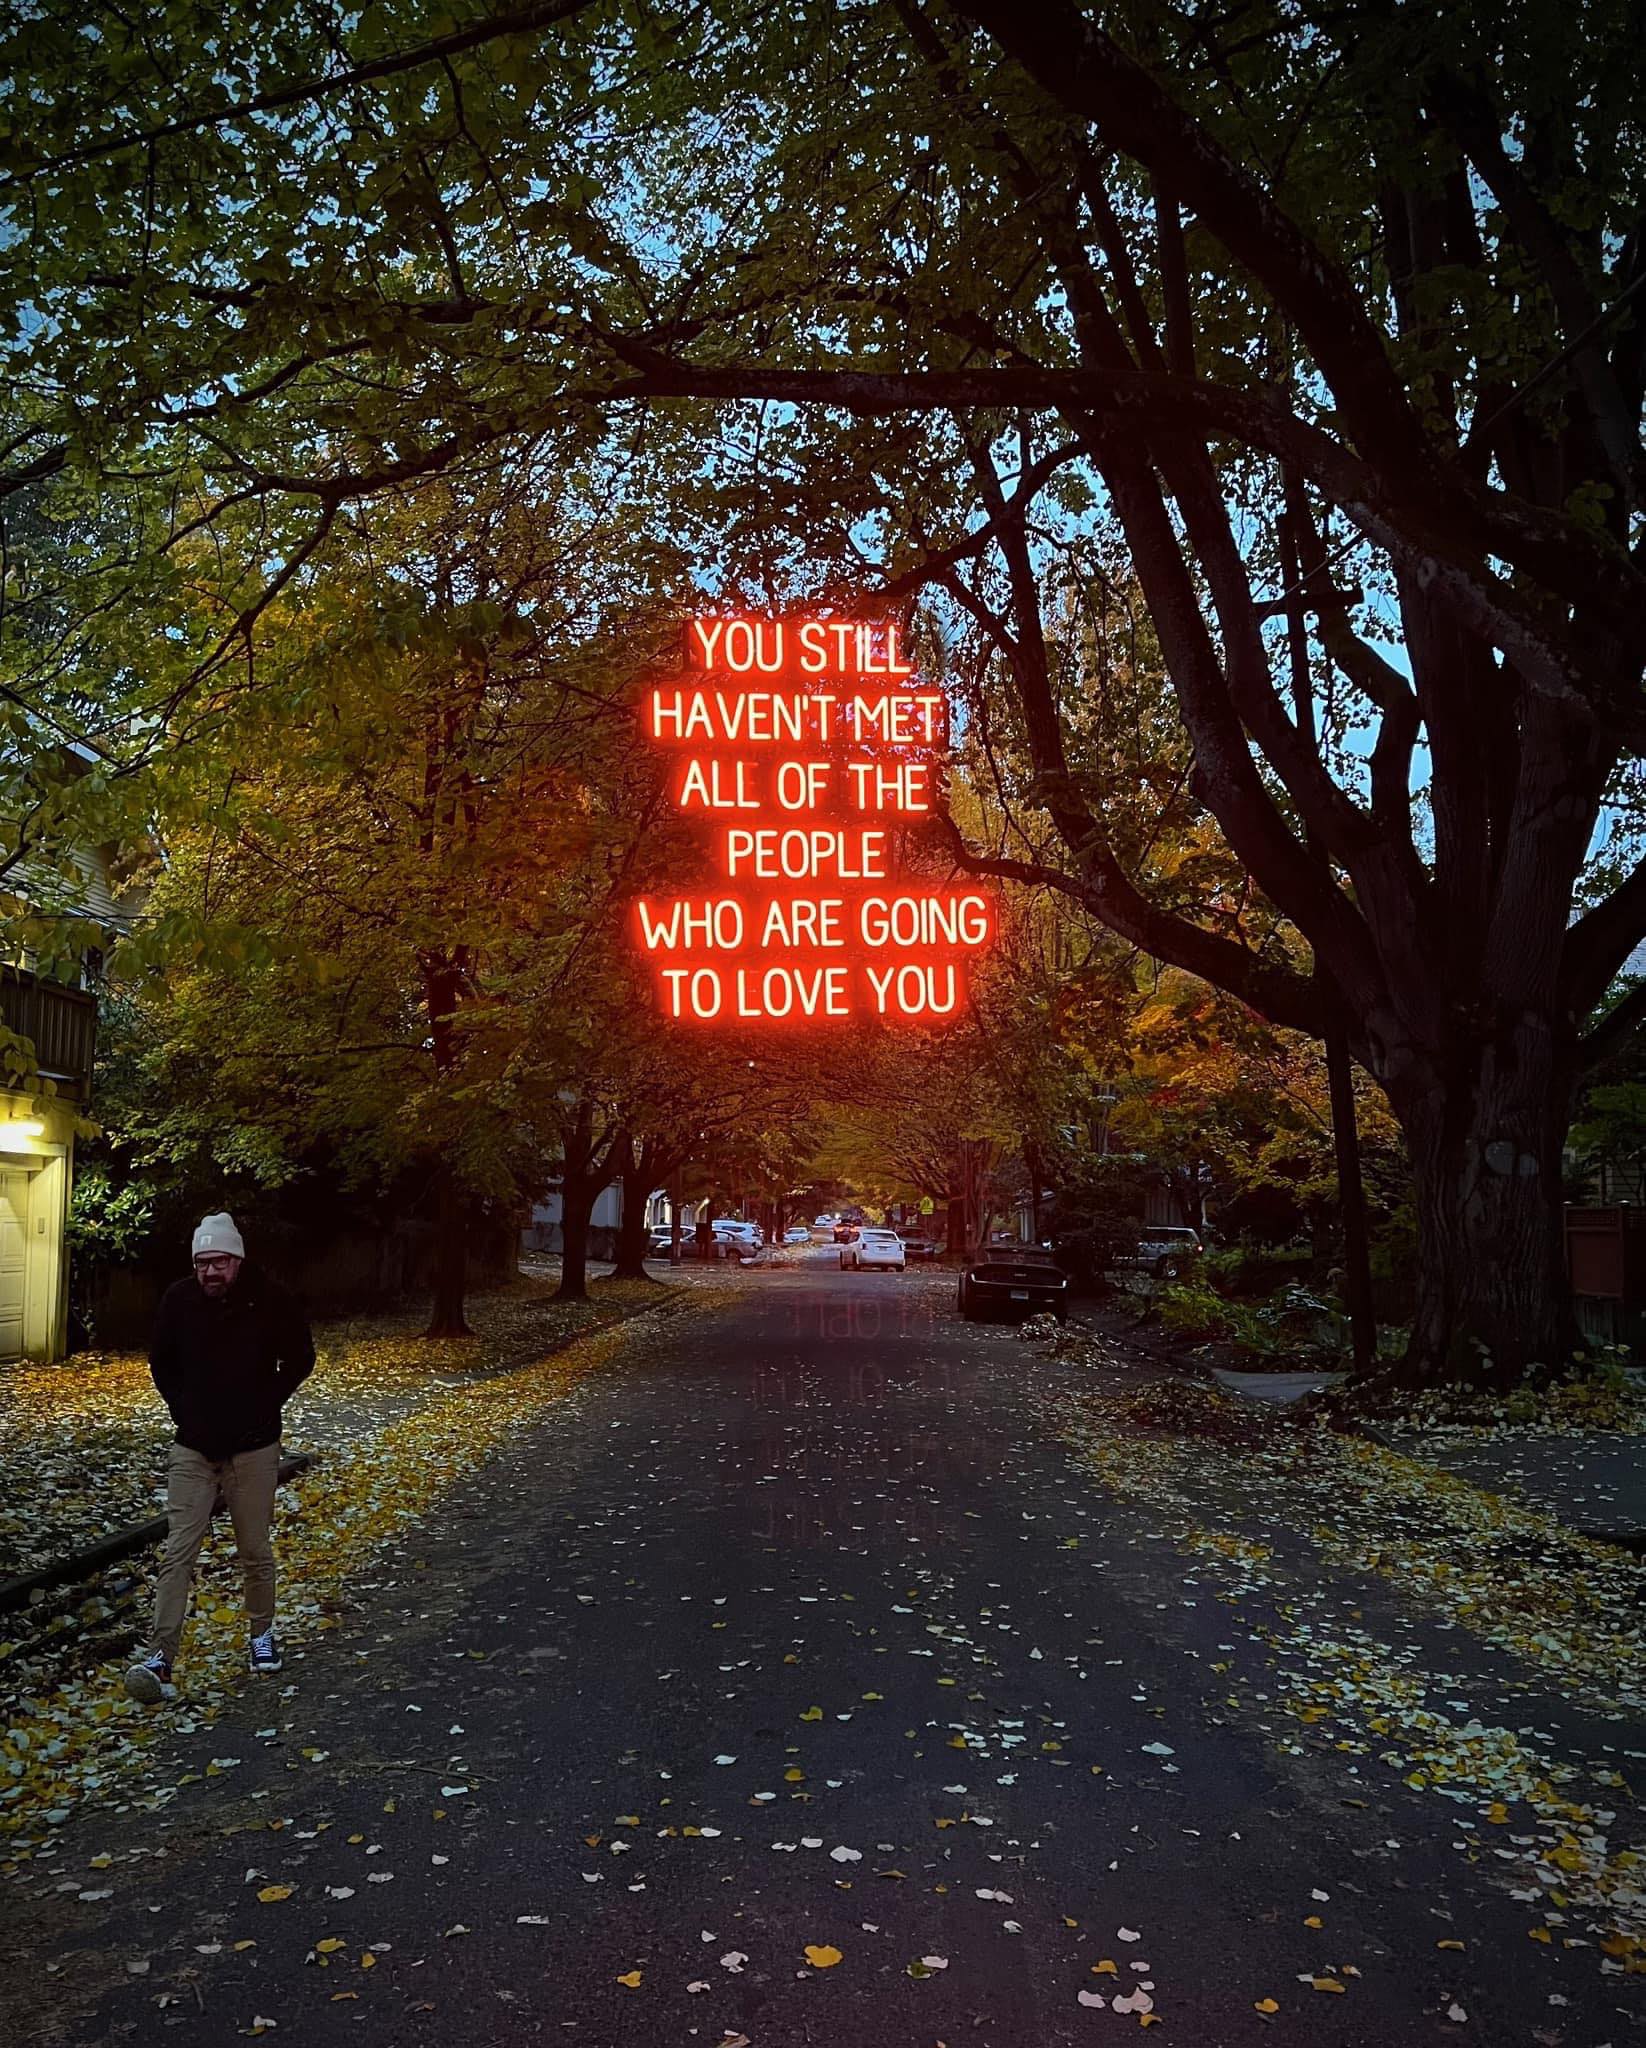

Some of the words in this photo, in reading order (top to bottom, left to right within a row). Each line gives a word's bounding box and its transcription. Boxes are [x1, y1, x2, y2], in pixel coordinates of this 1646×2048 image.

[694, 621, 783, 670] YOU
[800, 623, 911, 673] STILL
[653, 690, 836, 741] HAVEN'T
[854, 695, 941, 742] MET
[680, 760, 760, 808] ALL
[777, 761, 831, 809] OF
[848, 763, 929, 811] THE
[727, 829, 886, 878] PEOPLE
[637, 899, 744, 950] WHO
[761, 899, 844, 948] ARE
[860, 896, 988, 946] GOING
[661, 968, 721, 1018] TO
[736, 966, 849, 1018] LOVE
[865, 964, 956, 1014] YOU
